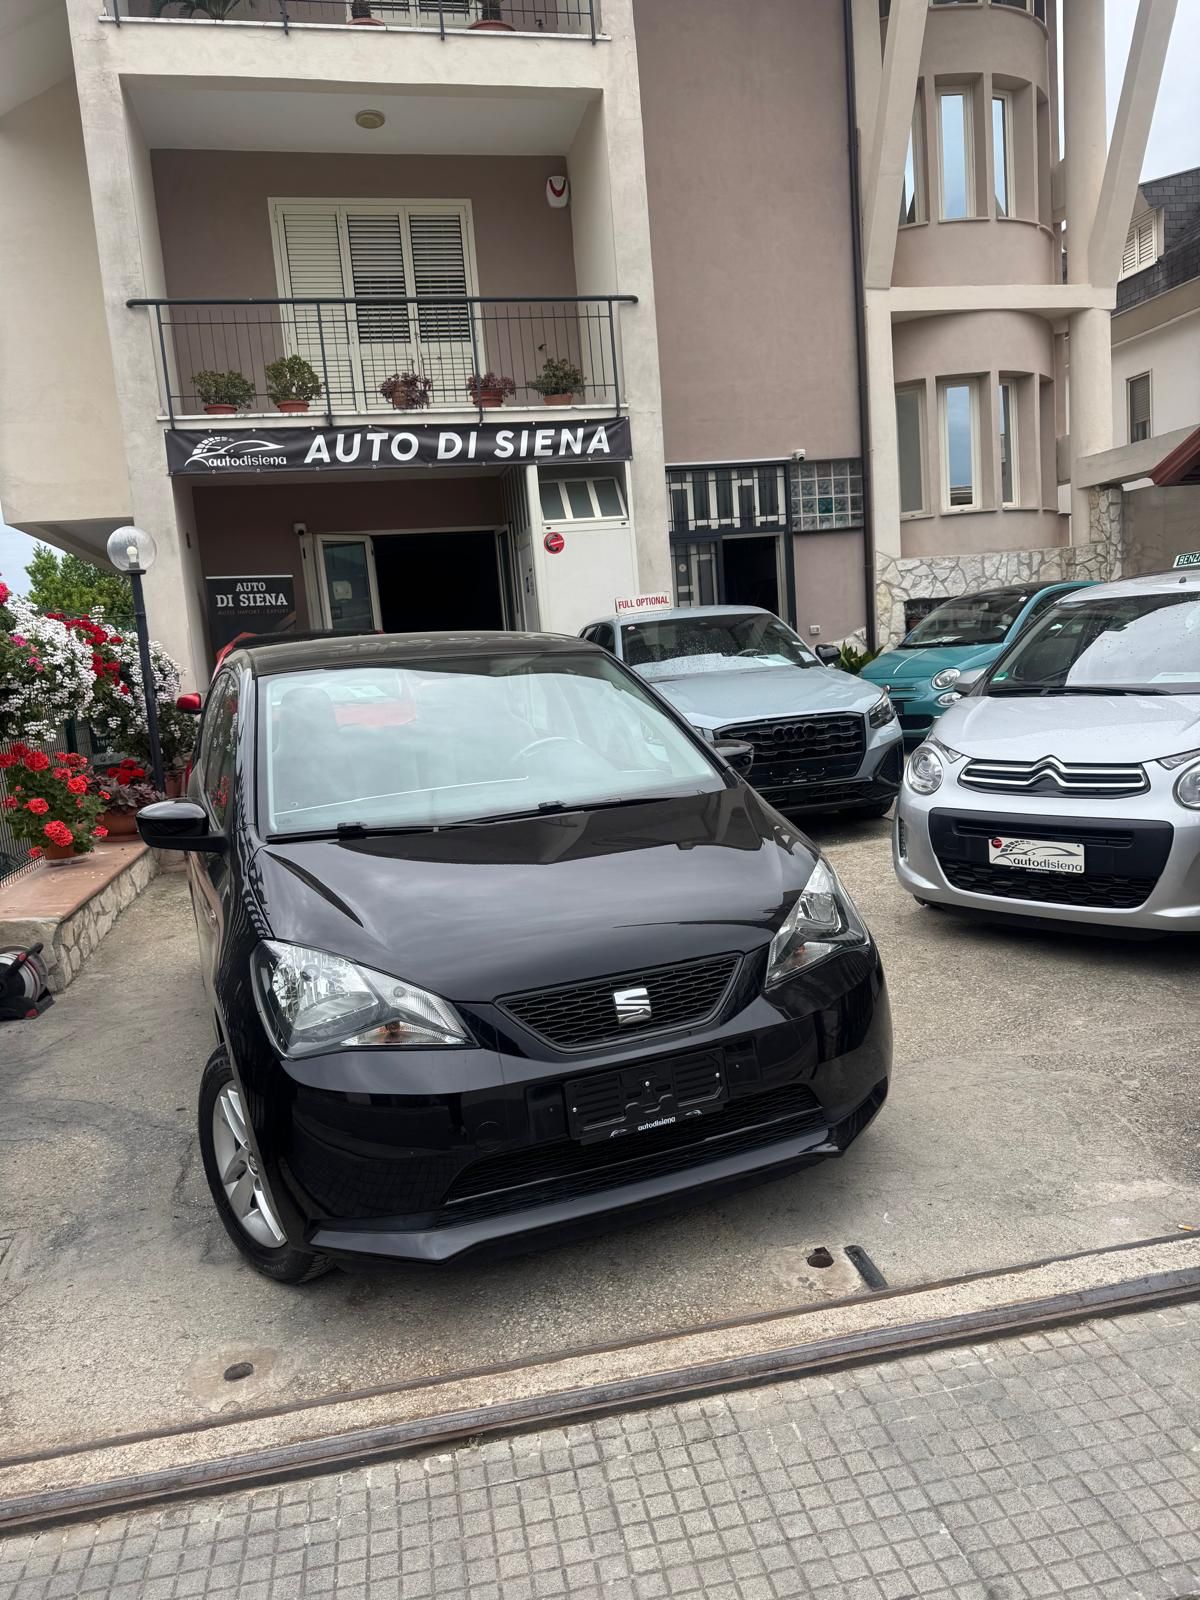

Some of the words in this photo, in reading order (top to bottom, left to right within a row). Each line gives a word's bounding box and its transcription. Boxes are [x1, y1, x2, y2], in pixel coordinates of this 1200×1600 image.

[304, 432, 419, 463] AUTO
[437, 431, 477, 460] DI
[494, 426, 611, 458] SIENA
[208, 454, 287, 467] autodisiena
[235, 582, 266, 591] AUTO
[215, 594, 234, 607] DI
[239, 593, 288, 606] SIENA
[617, 600, 635, 609] FULL
[635, 596, 670, 606] OPTIONAL
[1013, 857, 1083, 872] autodisiena
[637, 1116, 676, 1131] autodisiena
